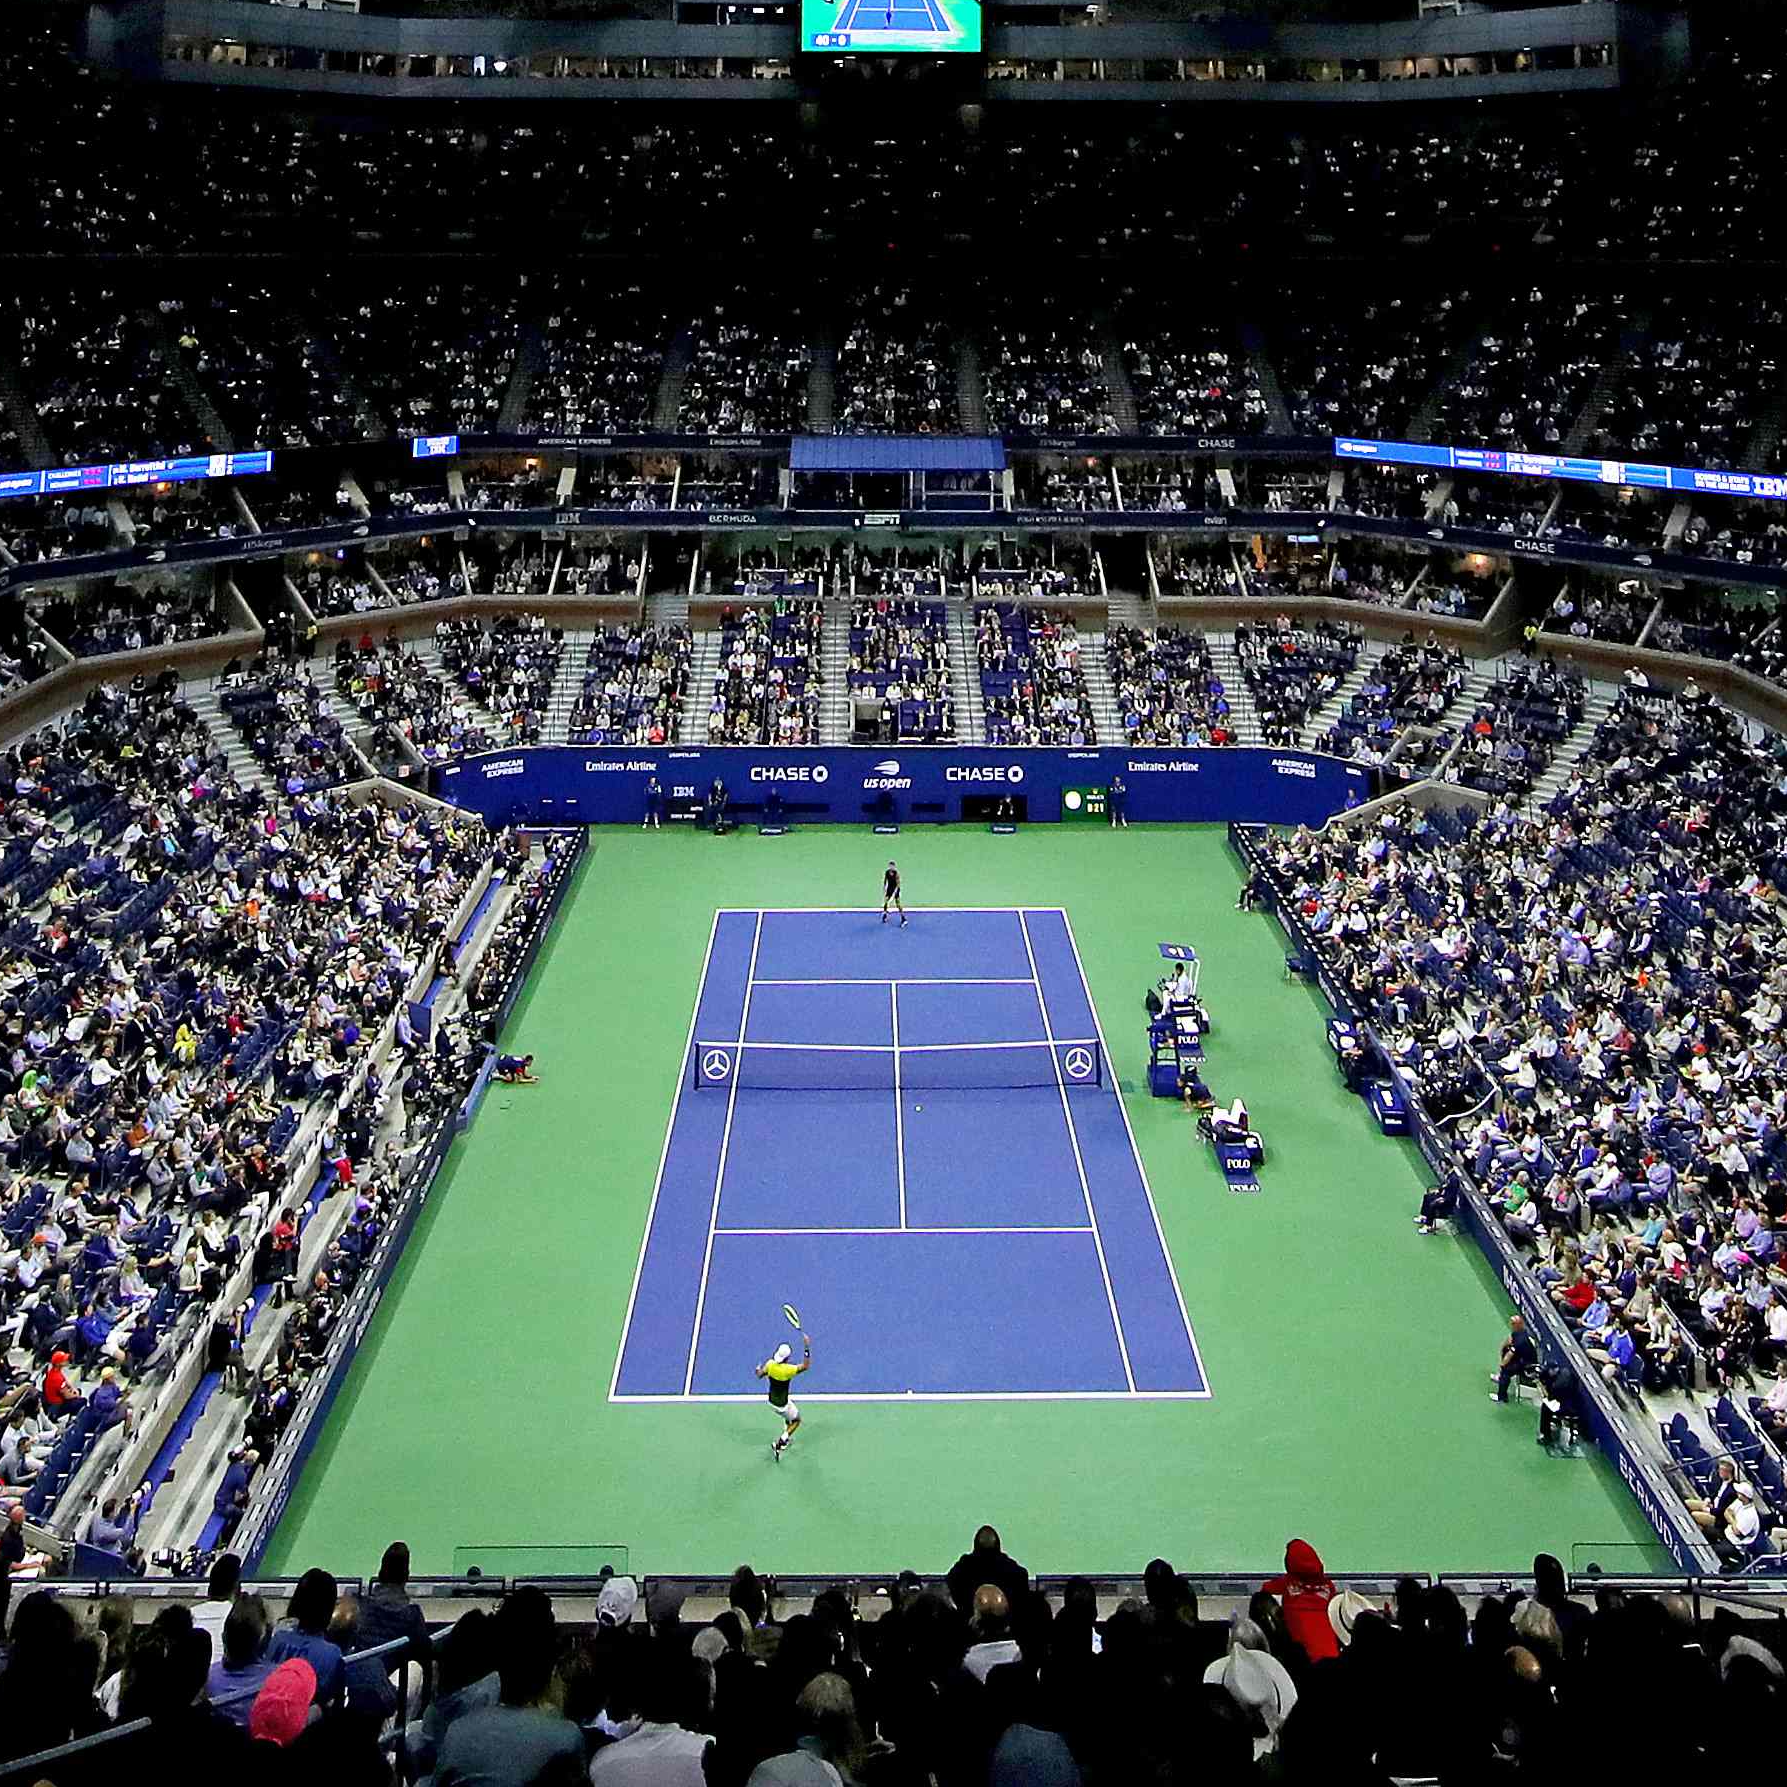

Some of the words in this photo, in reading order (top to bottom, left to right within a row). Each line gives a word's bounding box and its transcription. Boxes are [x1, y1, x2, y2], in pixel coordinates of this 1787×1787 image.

[815, 35, 830, 46] 40
[838, 35, 847, 46] 0
[1197, 438, 1236, 449] CHASE
[708, 514, 757, 523] BERMUDA
[1514, 539, 1556, 554] CHASE
[585, 761, 623, 772] Emirates
[626, 761, 657, 772] Airline
[1128, 761, 1167, 772] Emirates
[1168, 761, 1199, 772] Airline
[751, 767, 810, 781] CHASE
[946, 767, 1006, 781] CHASE
[673, 786, 695, 797] IBM
[1177, 1035, 1199, 1045] POLO
[1226, 1158, 1251, 1169] POLO
[1229, 1184, 1261, 1192] POLO
[1619, 1451, 1683, 1568] BERMUDA
